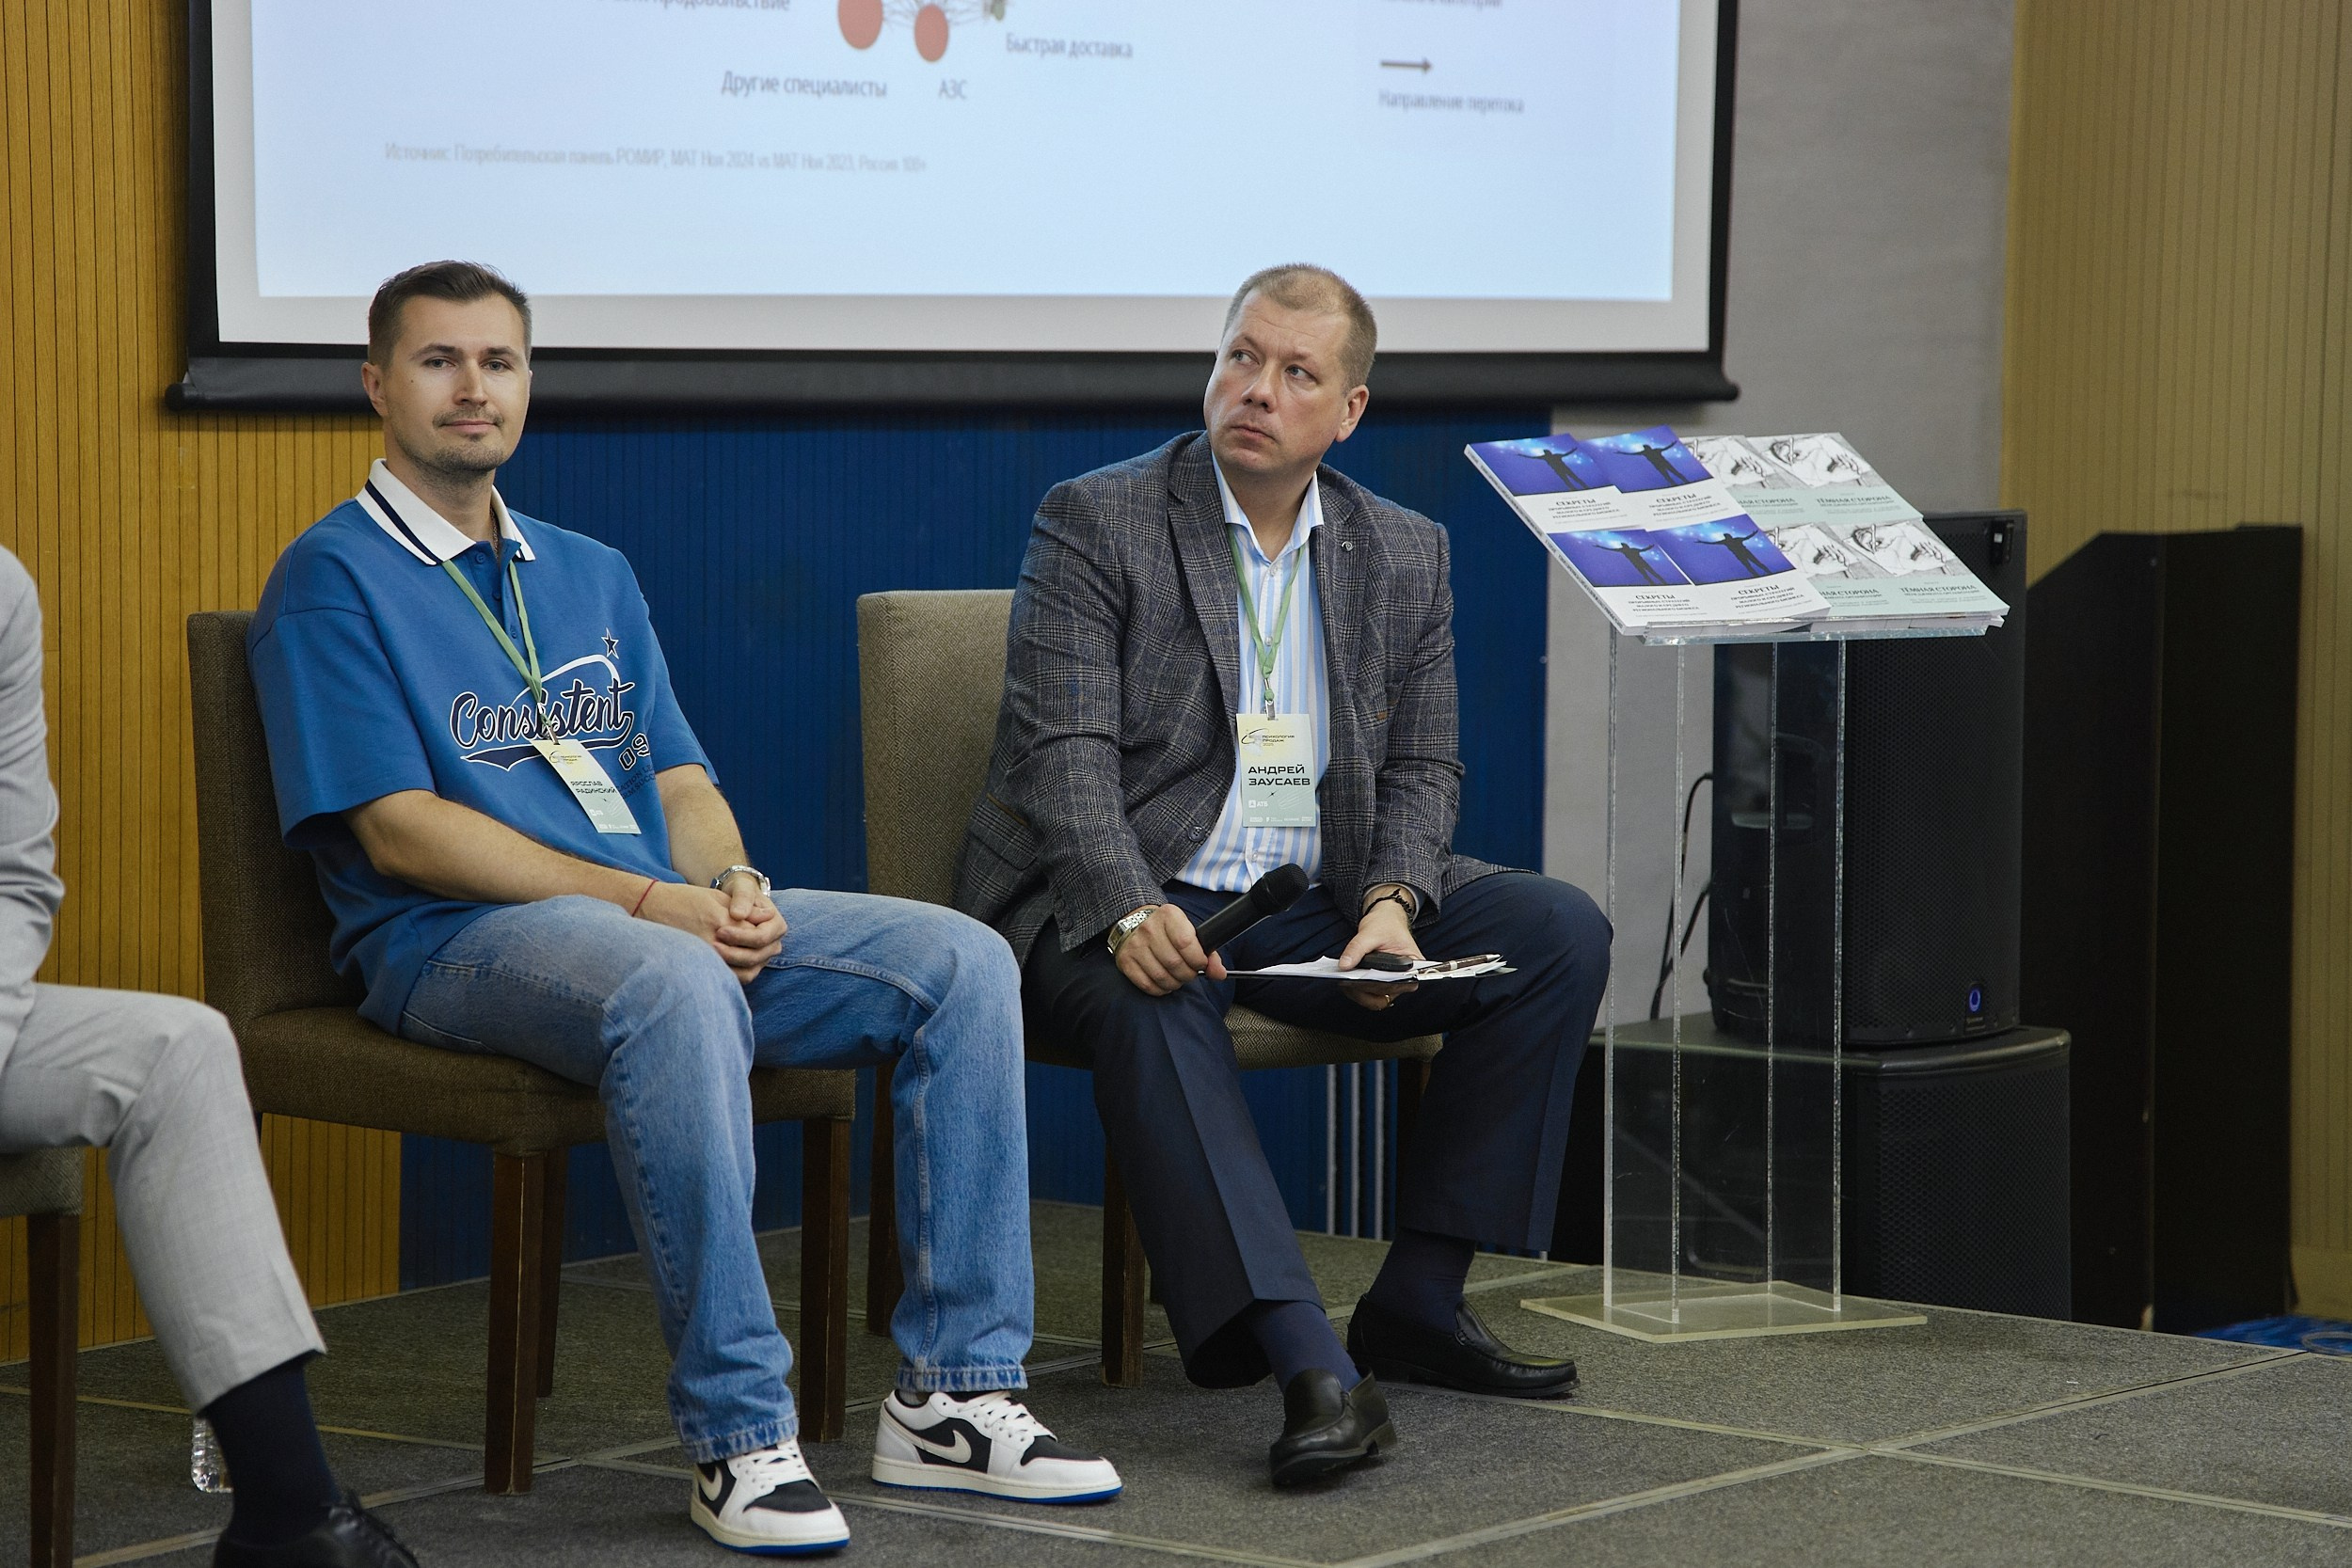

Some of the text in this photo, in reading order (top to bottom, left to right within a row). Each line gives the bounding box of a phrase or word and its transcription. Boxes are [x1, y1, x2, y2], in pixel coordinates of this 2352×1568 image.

[1006, 32, 1134, 58] Быстрая доставка
[721, 71, 888, 99] Другие специалисты
[939, 79, 969, 100] АЗС
[453, 143, 565, 165] Потребительская
[1656, 493, 1696, 503] СЕКРЕТЫ
[1738, 584, 1780, 595] СЕКРЕТЫ
[450, 678, 635, 749] Consistent
[619, 733, 650, 770] 09
[1248, 764, 1305, 775] АНДРЕЙ
[1248, 778, 1311, 786] ЗАУСАЕВ
